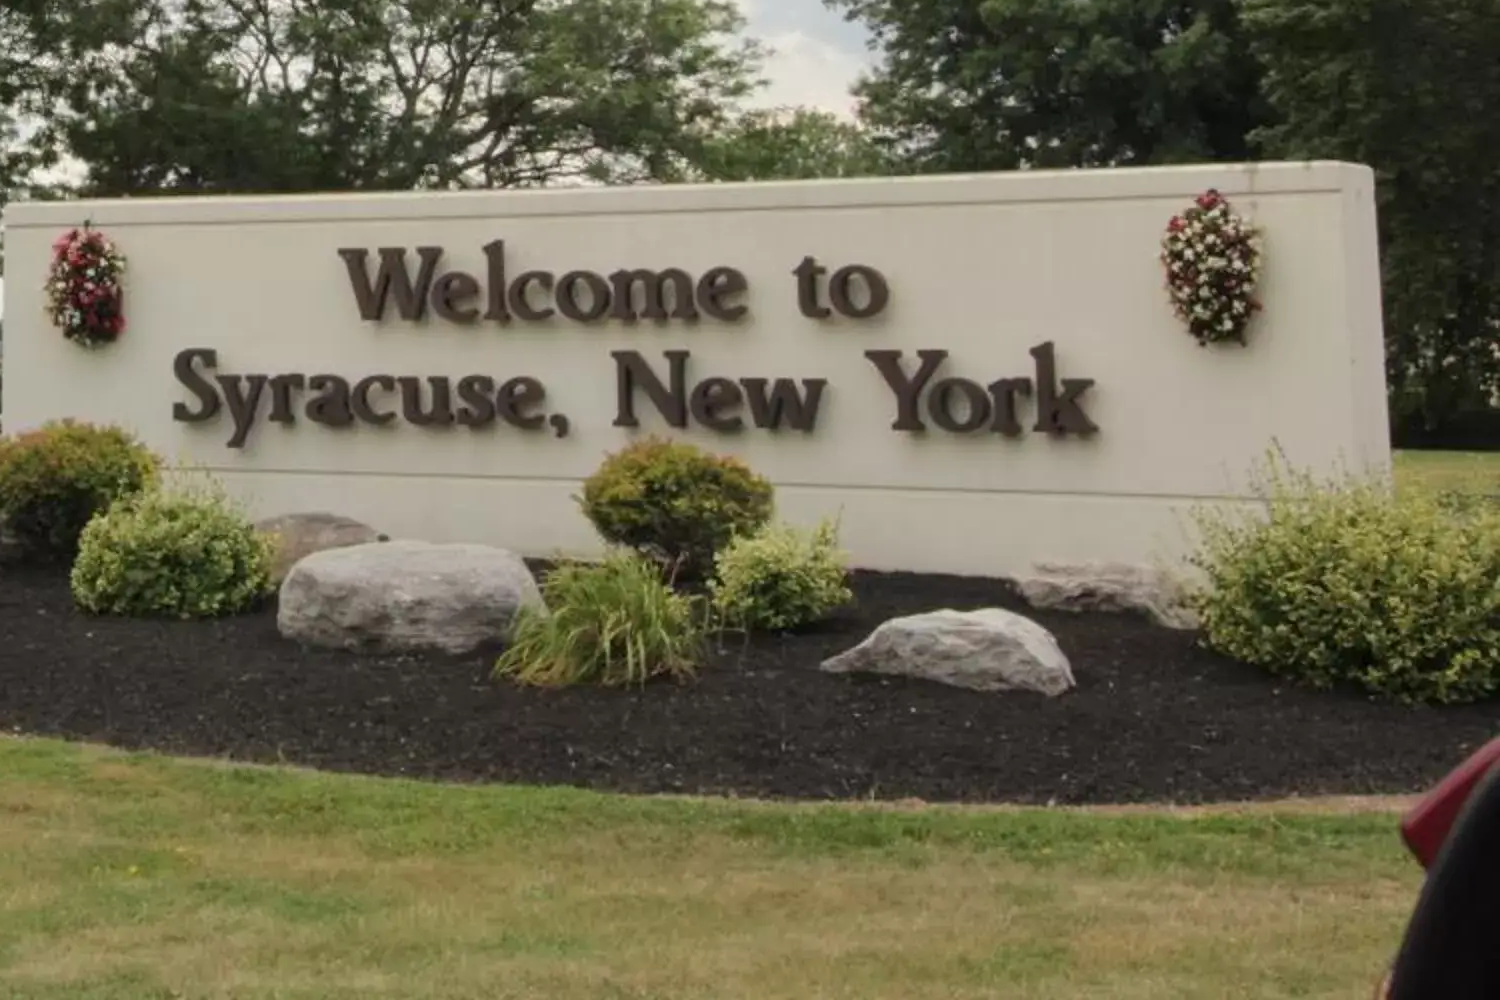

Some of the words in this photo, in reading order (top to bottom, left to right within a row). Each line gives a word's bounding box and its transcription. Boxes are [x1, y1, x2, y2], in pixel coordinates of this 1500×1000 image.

[338, 240, 748, 325] Welcome
[793, 257, 890, 321] to
[173, 348, 568, 449] Syracuse,
[611, 350, 827, 436] New
[865, 341, 1100, 436] York
